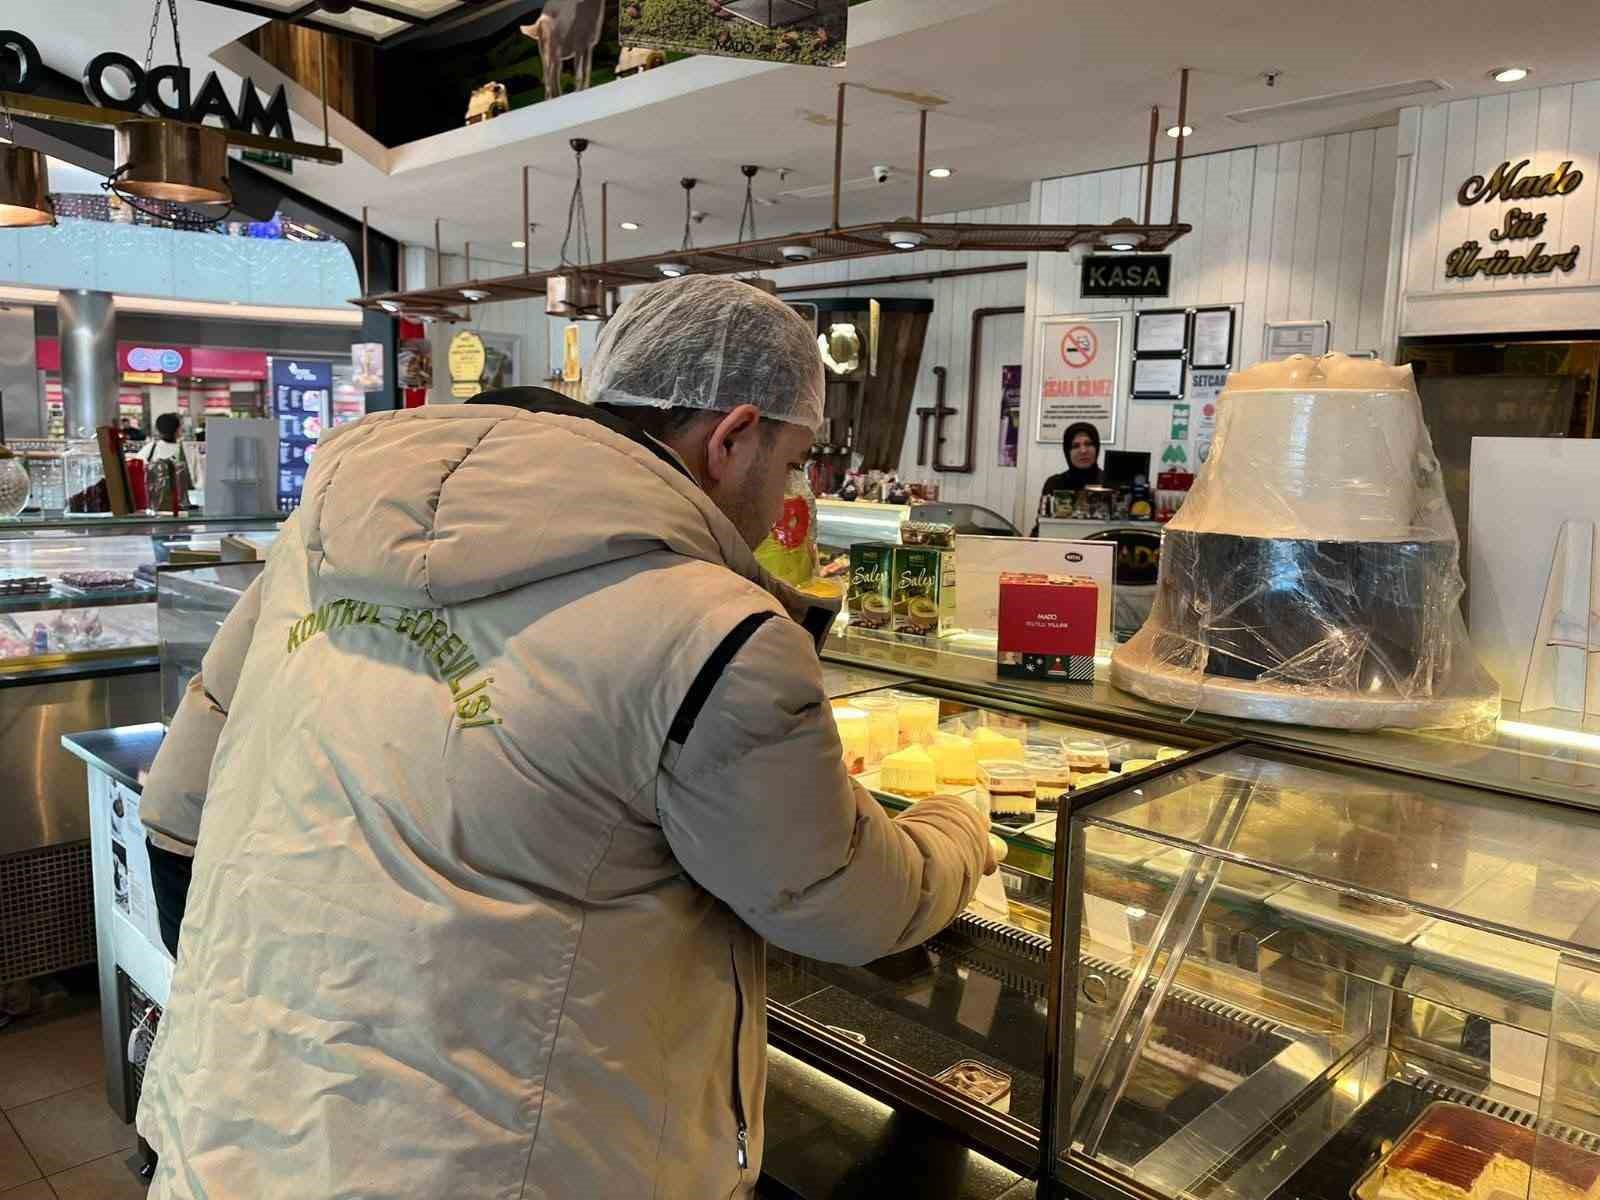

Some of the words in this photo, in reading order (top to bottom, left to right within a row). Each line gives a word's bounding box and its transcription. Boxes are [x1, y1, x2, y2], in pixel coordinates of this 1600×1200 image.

[714, 40, 755, 54] MADO
[1457, 159, 1583, 206] Mado
[1489, 207, 1547, 241] Süt
[1089, 265, 1161, 287] KASA
[1445, 240, 1580, 278] Ürünleri
